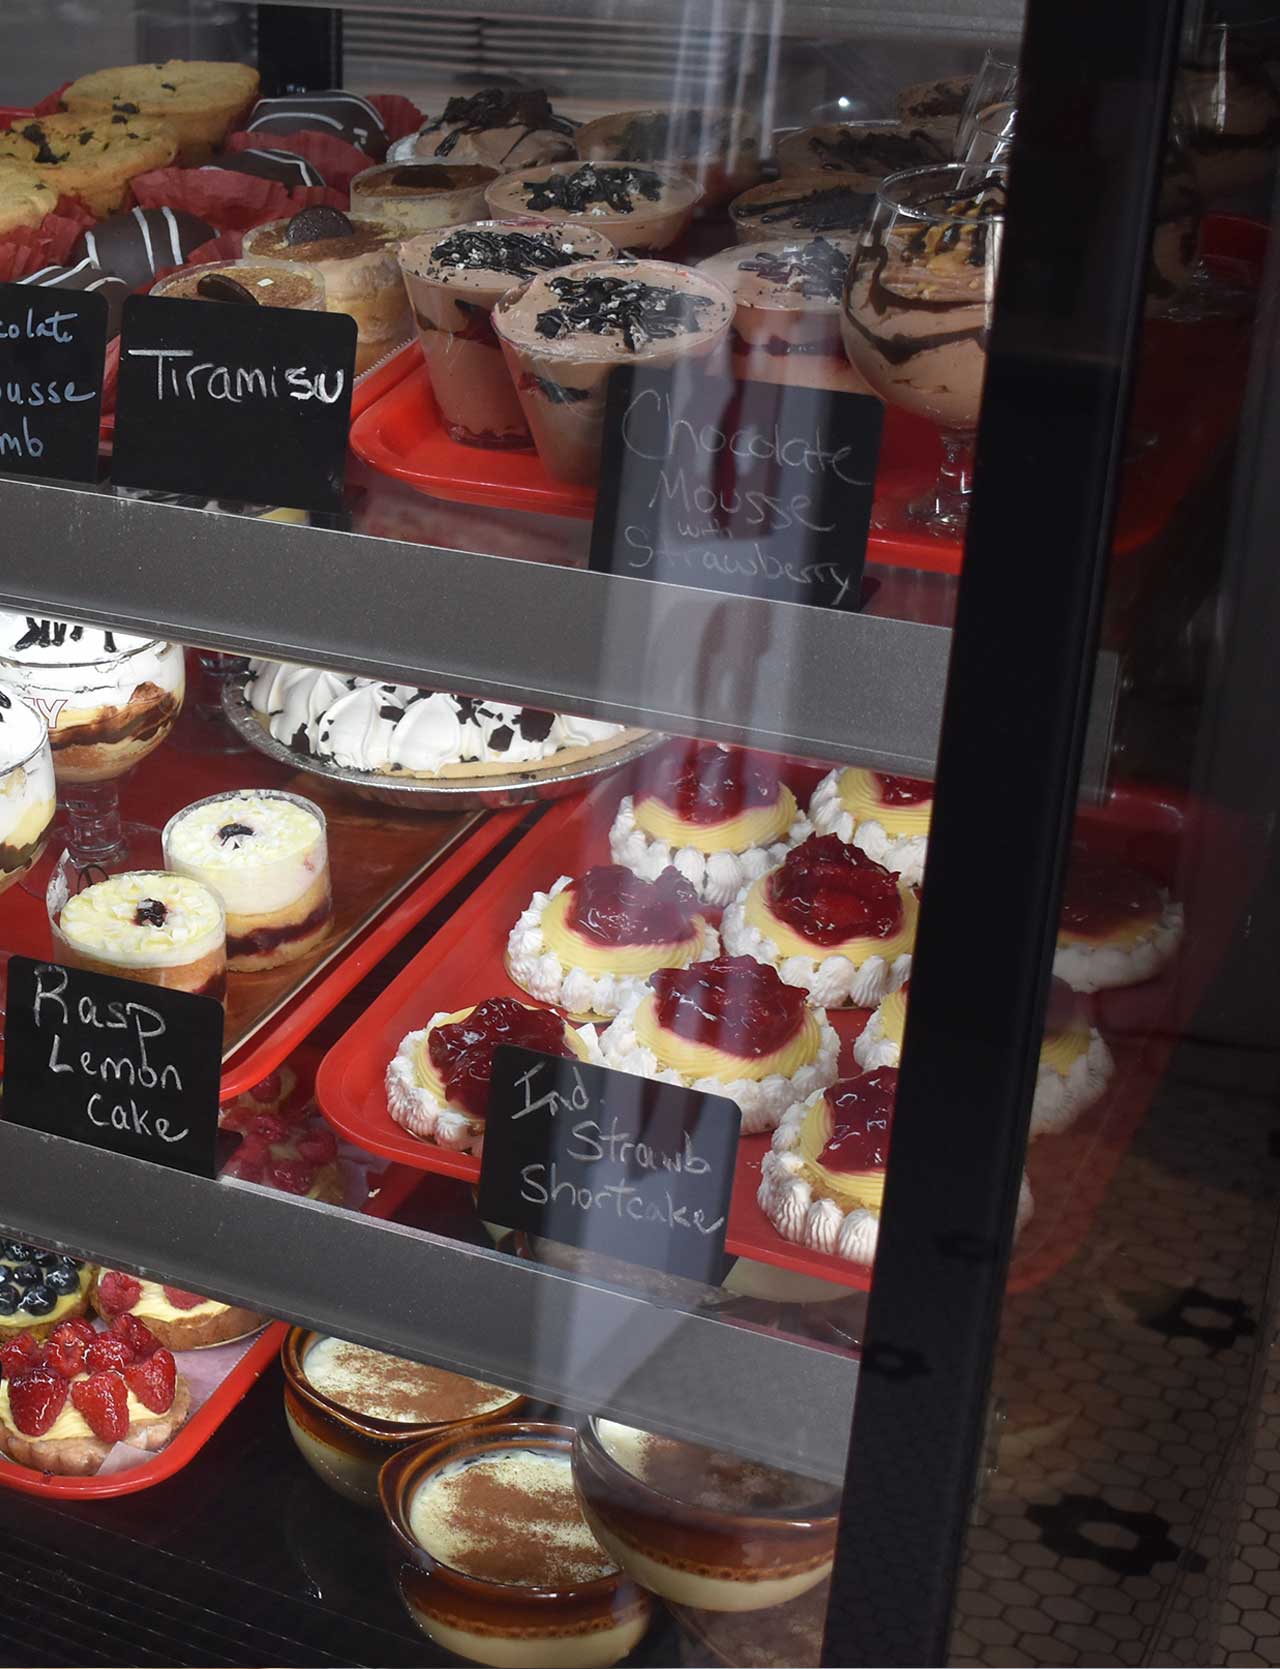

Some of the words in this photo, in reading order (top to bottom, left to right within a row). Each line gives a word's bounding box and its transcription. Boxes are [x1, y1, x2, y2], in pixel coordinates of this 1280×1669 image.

[128, 347, 344, 404] Tiramisu
[622, 388, 872, 485] Chocolate
[647, 466, 836, 532] Mousse
[624, 525, 851, 606] Strawberry
[33, 965, 167, 1070] Rasp
[48, 1033, 183, 1092] Lemon
[566, 1116, 711, 1175] Strawb
[519, 1162, 725, 1235] Shortcake
